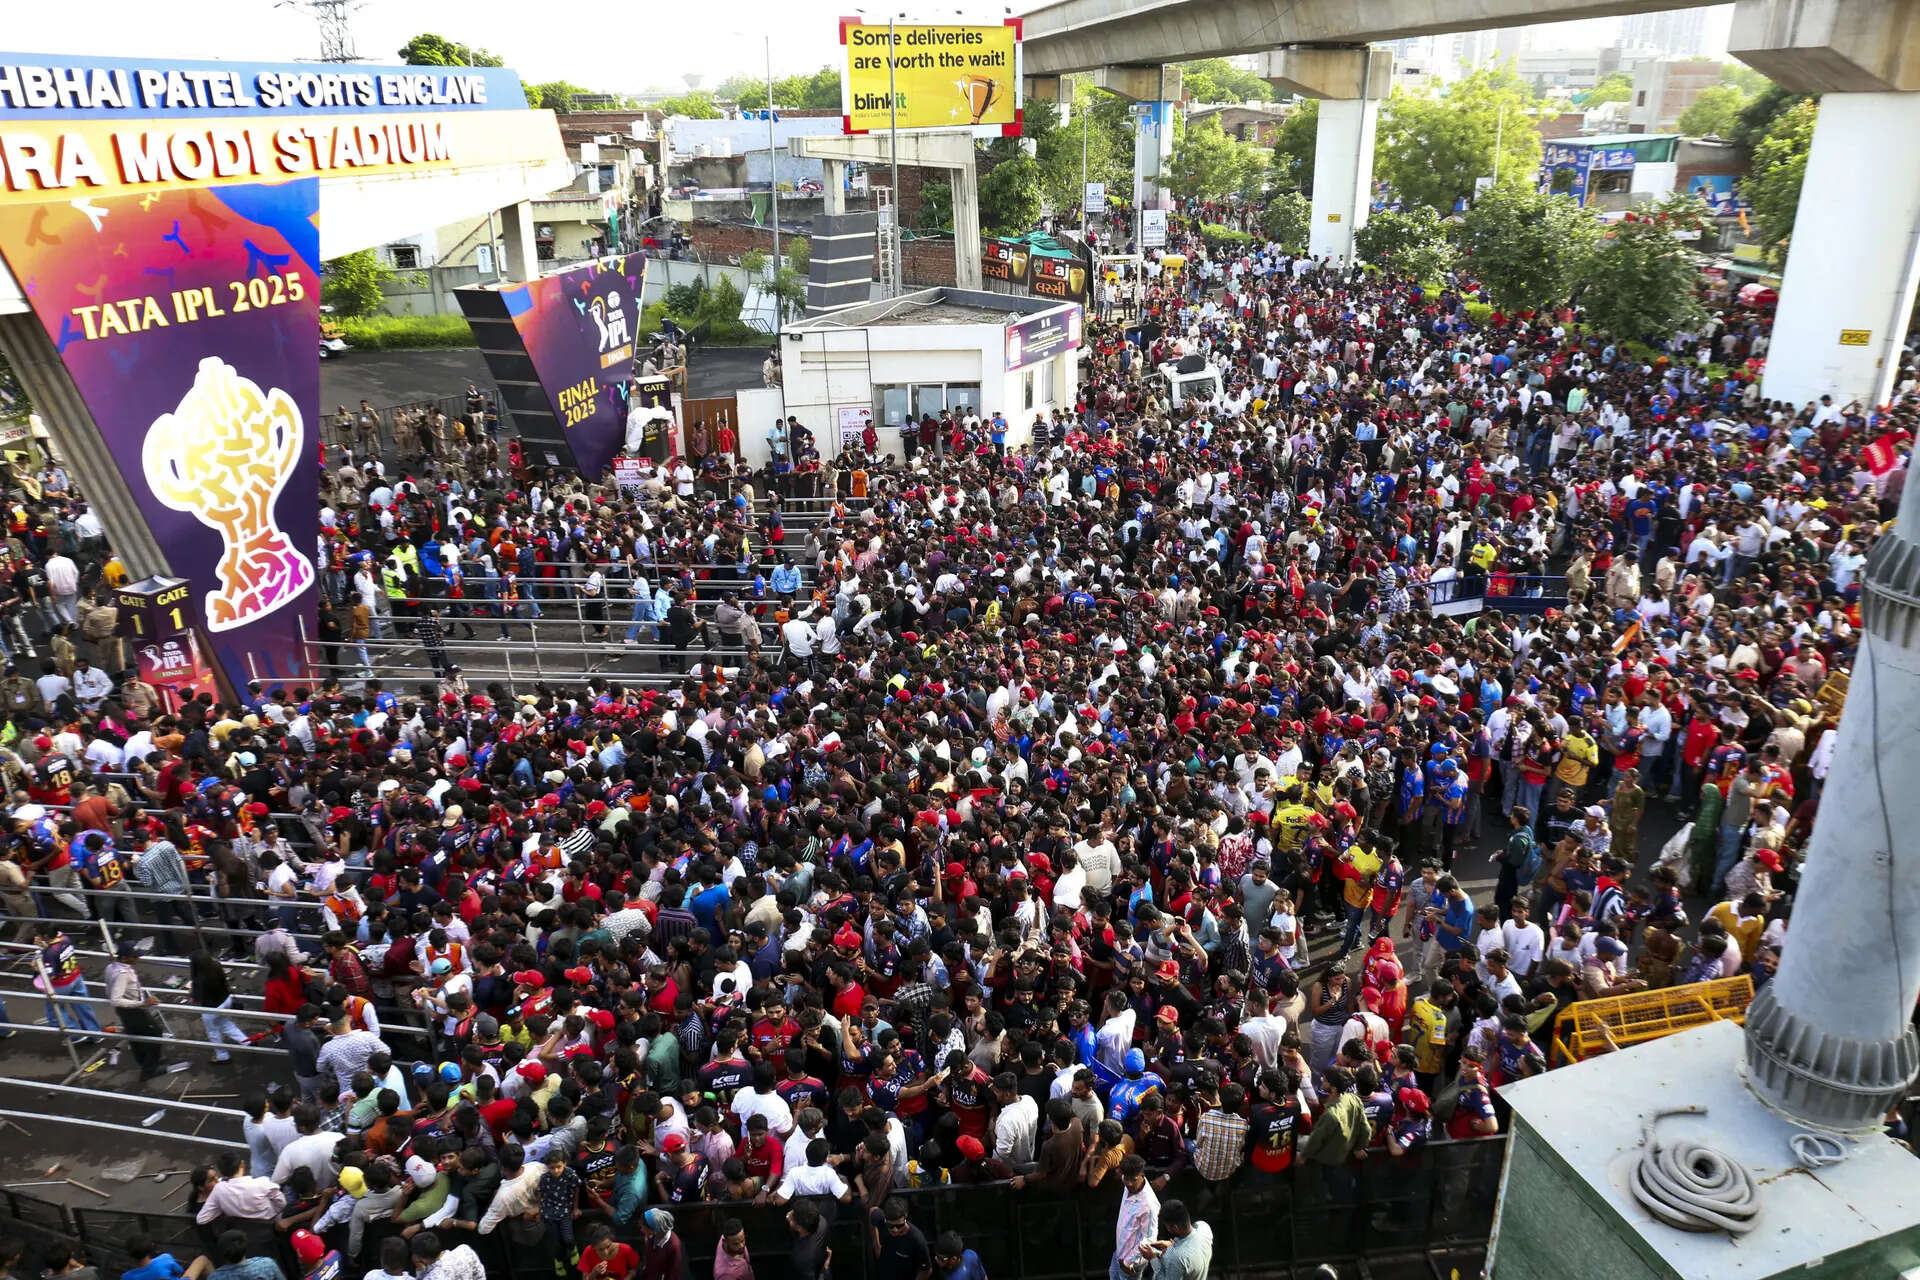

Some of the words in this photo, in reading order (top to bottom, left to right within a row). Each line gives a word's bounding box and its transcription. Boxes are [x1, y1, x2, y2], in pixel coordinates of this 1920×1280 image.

[853, 30, 901, 46] Some
[906, 28, 983, 45] deliveries
[854, 56, 881, 69] are
[887, 52, 935, 68] worth
[939, 51, 965, 67] the
[968, 50, 1006, 66] wait!
[0, 66, 132, 108] HBHAI
[133, 70, 256, 108] PATEL
[254, 72, 377, 108] SPORTS
[376, 75, 488, 105] ENCLAVE
[854, 93, 907, 110] blinkit
[110, 128, 265, 184] MODI
[272, 122, 453, 173] STADIUM
[988, 243, 1013, 264] Raj
[1043, 261, 1070, 281] Raj
[72, 296, 170, 340] TATA
[172, 286, 225, 323] IPL
[229, 272, 304, 312] 2025
[608, 317, 631, 348] IPL
[558, 376, 599, 411] FINAL
[643, 383, 667, 392] GATE
[651, 394, 660, 408] 1
[565, 398, 596, 428] 2025
[120, 594, 147, 608] GATE
[156, 586, 190, 606] GATE
[131, 614, 144, 635] 1
[168, 607, 185, 630] 1
[162, 655, 192, 669] IPL
[51, 770, 71, 788] 18
[100, 860, 121, 882] 18
[712, 1074, 741, 1086] KEI
[1269, 1116, 1294, 1129] KEI
